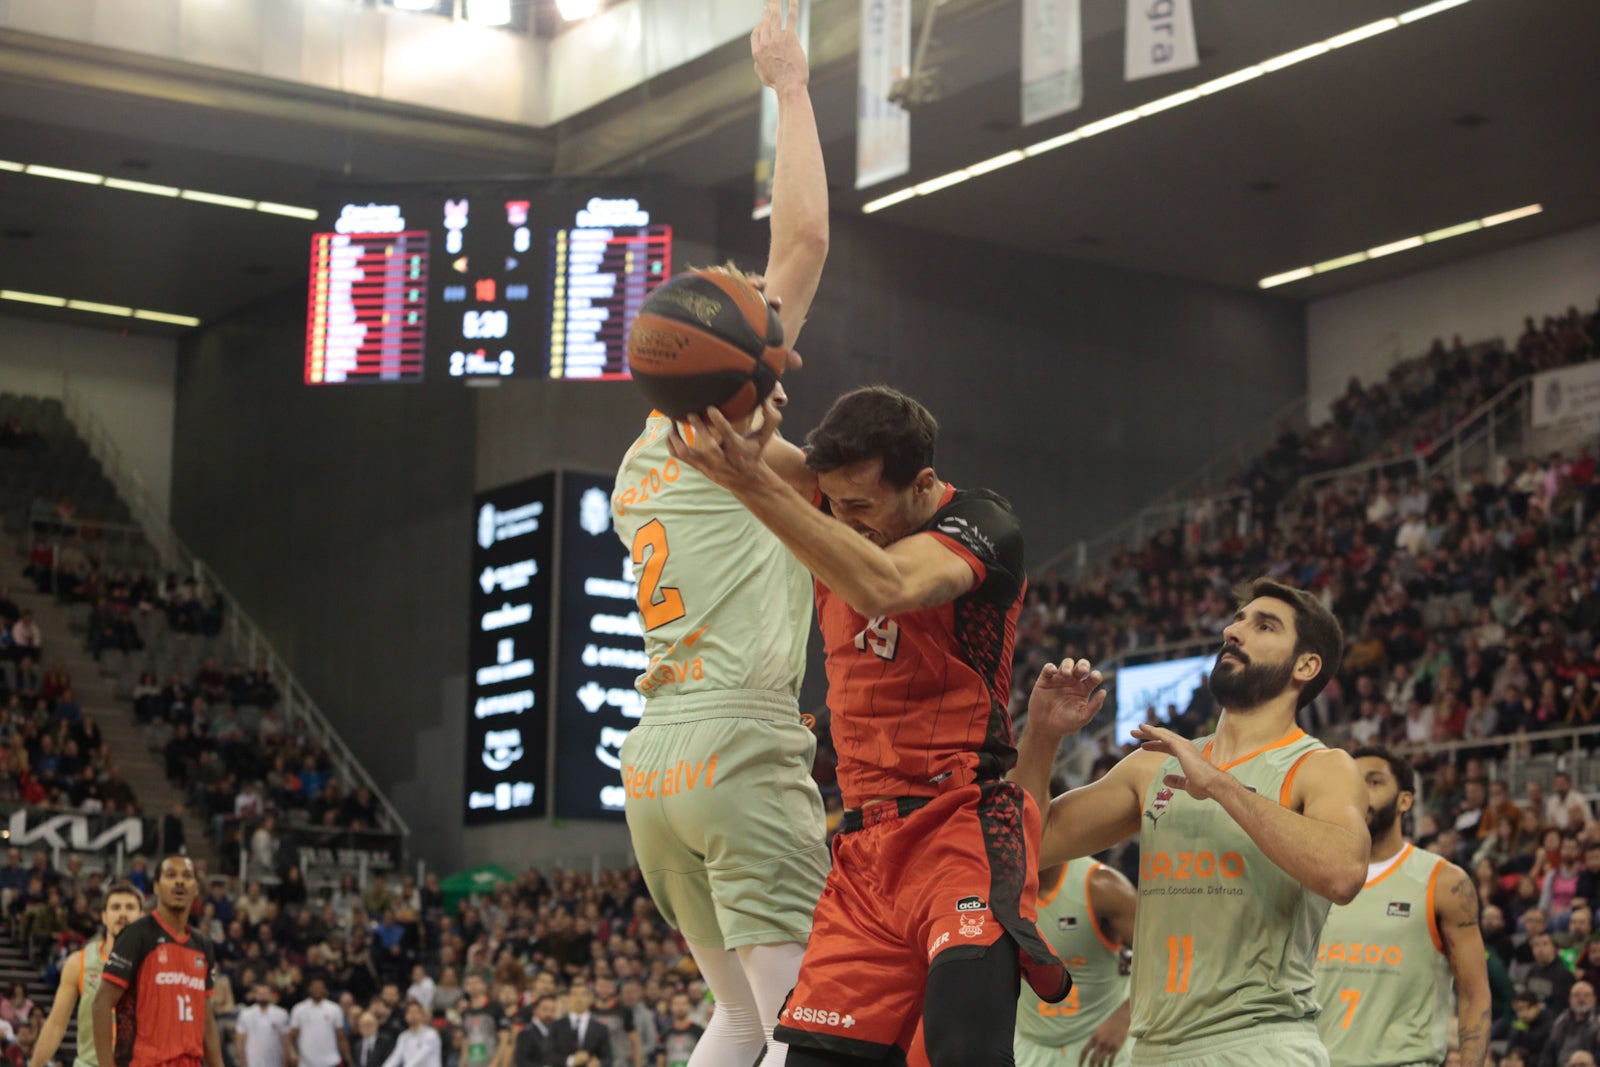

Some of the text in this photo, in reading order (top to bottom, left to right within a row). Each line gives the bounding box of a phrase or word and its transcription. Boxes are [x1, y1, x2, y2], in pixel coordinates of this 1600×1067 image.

[632, 518, 686, 633] 2
[1140, 850, 1245, 880] CAZOO
[959, 901, 981, 910] acb
[1165, 935, 1193, 993] 11
[793, 1006, 840, 1026] asisa
[1340, 989, 1361, 1030] 7
